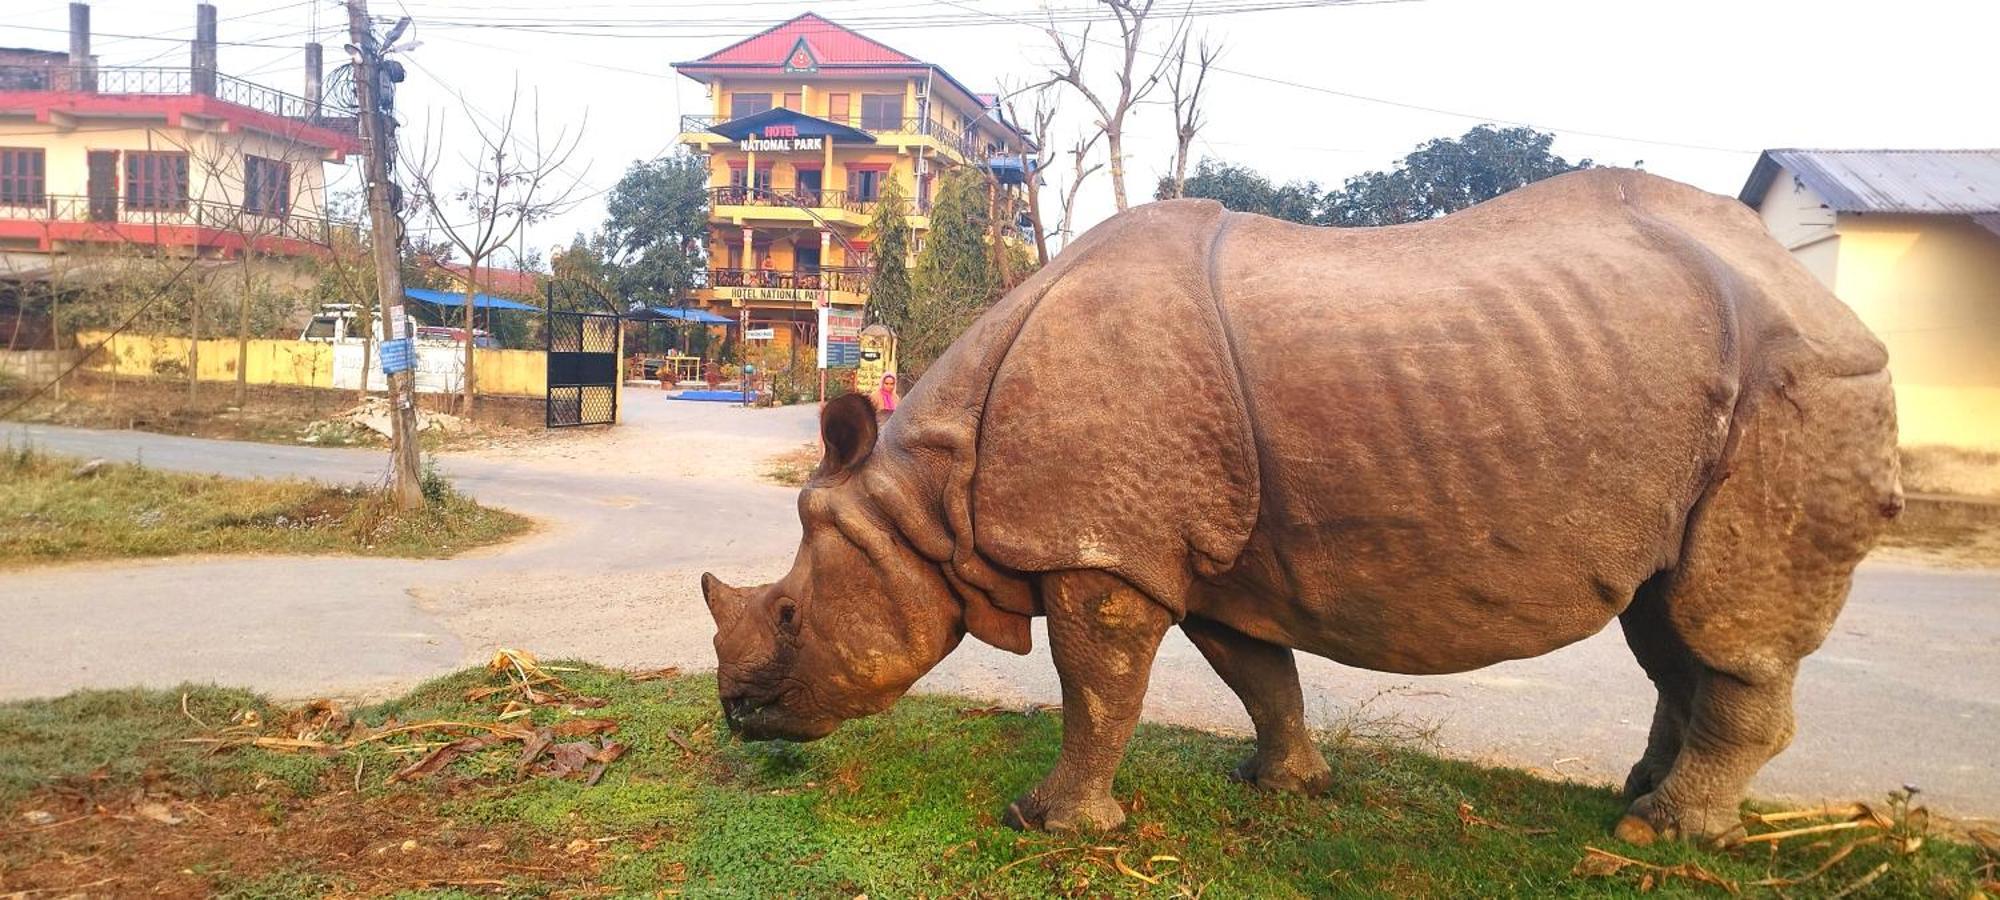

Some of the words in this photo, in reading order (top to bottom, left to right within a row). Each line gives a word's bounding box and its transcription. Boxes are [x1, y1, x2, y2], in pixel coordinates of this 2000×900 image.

[765, 126, 798, 137] HOTEL
[741, 139, 790, 151] NATIONAL
[794, 138, 822, 150] PARK
[732, 288, 756, 299] HOTEL
[760, 289, 801, 300] NATIONAL
